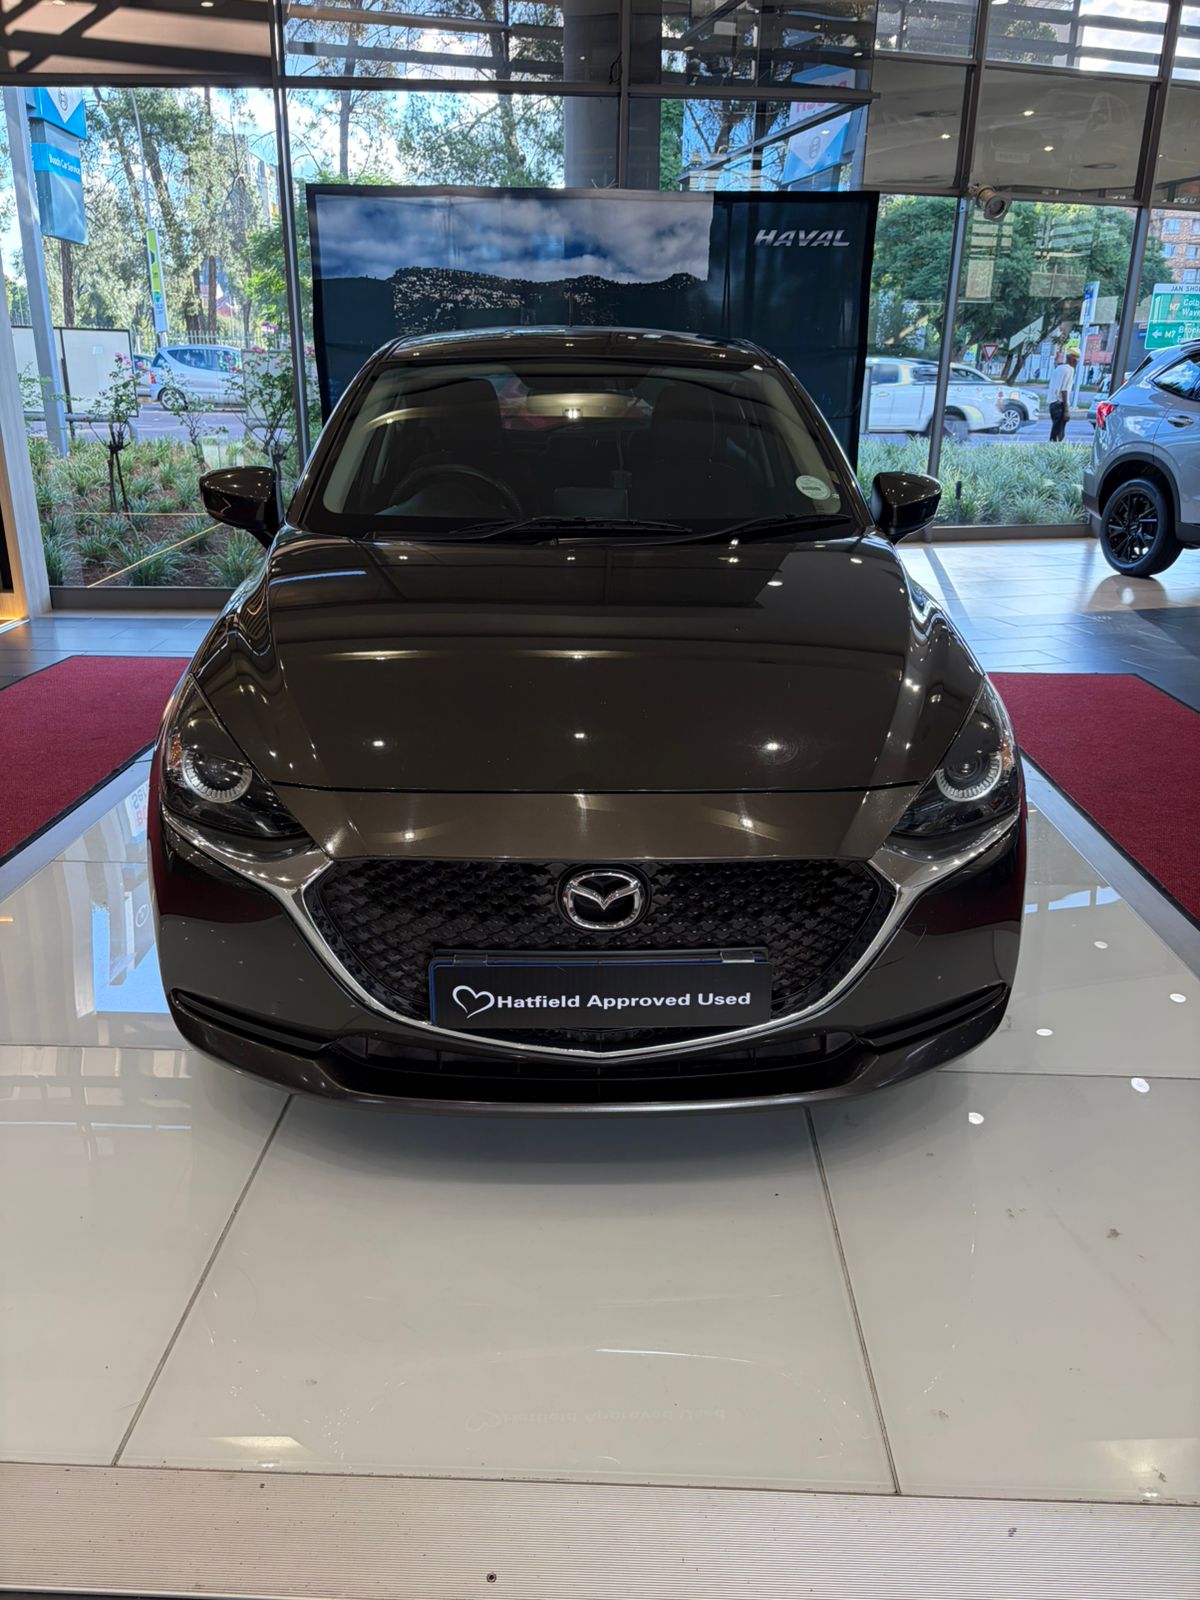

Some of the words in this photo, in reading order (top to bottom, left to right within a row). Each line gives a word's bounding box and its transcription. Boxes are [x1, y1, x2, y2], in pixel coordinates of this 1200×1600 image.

[754, 229, 850, 247] HAVAL
[1169, 303, 1180, 311] M7
[1164, 329, 1176, 338] M7
[497, 995, 580, 1009] Hatfield
[587, 993, 691, 1010] Approved
[697, 992, 751, 1006] Used
